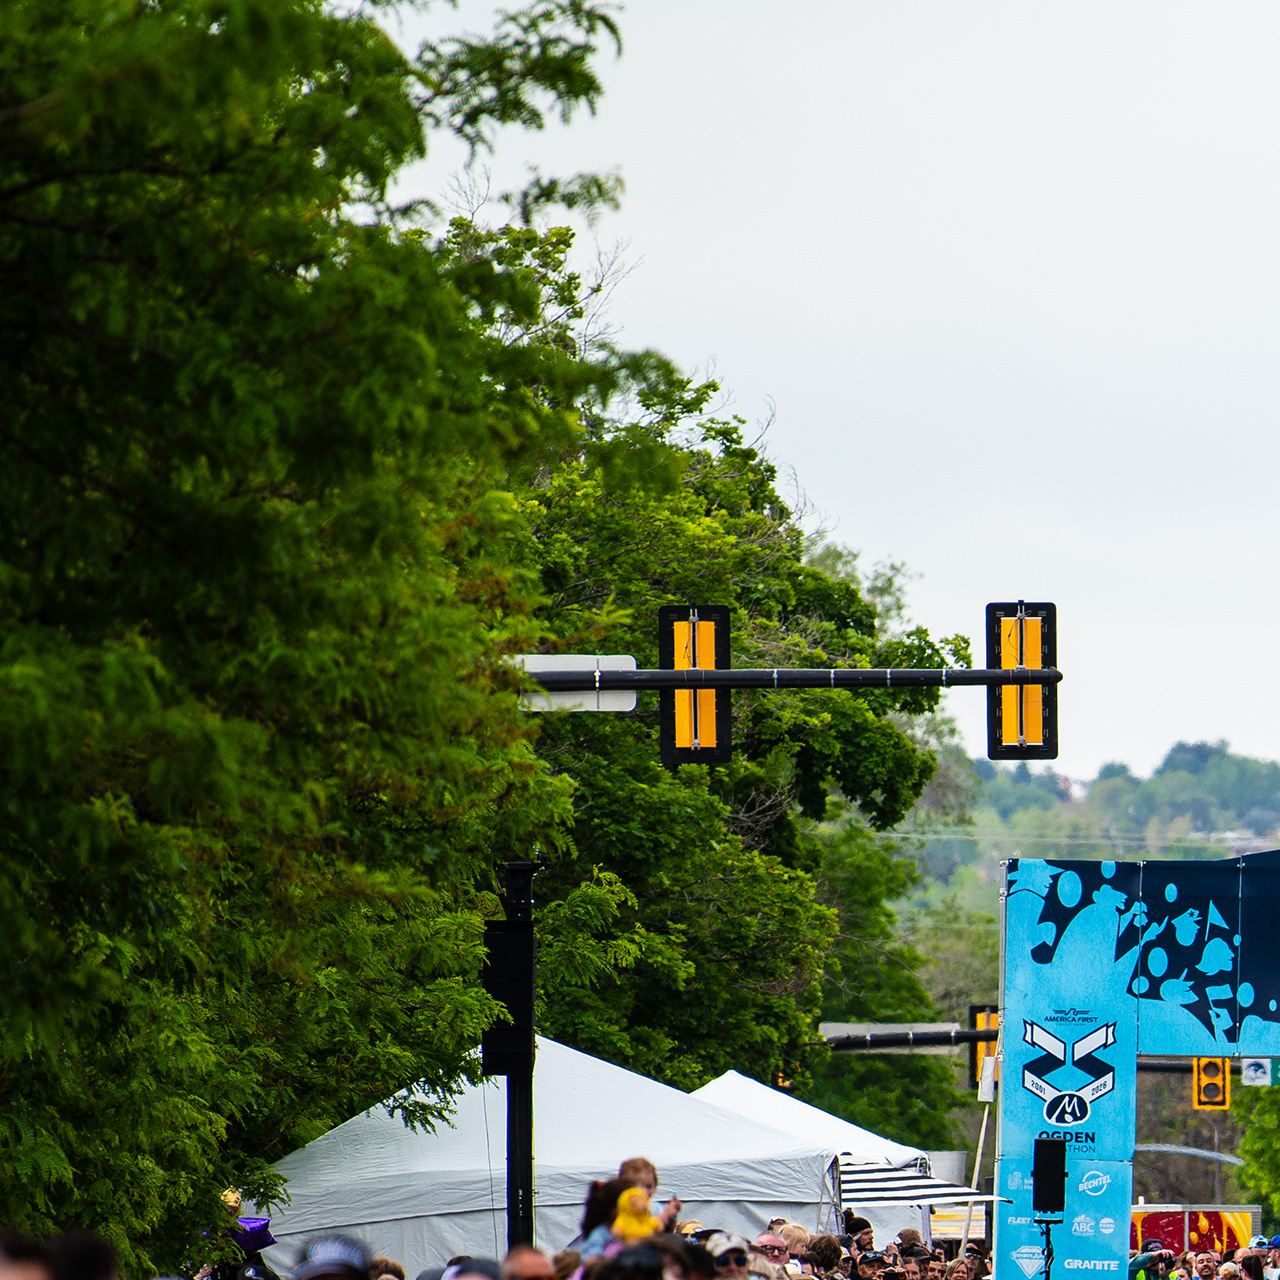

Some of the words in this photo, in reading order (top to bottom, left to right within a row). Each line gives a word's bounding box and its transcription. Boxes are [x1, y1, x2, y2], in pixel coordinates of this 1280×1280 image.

[1078, 1174, 1112, 1192] BECHTEL
[1008, 1216, 1032, 1224] FLEET
[1072, 1222, 1095, 1233] ABC
[1064, 1259, 1120, 1270] GRANITE
